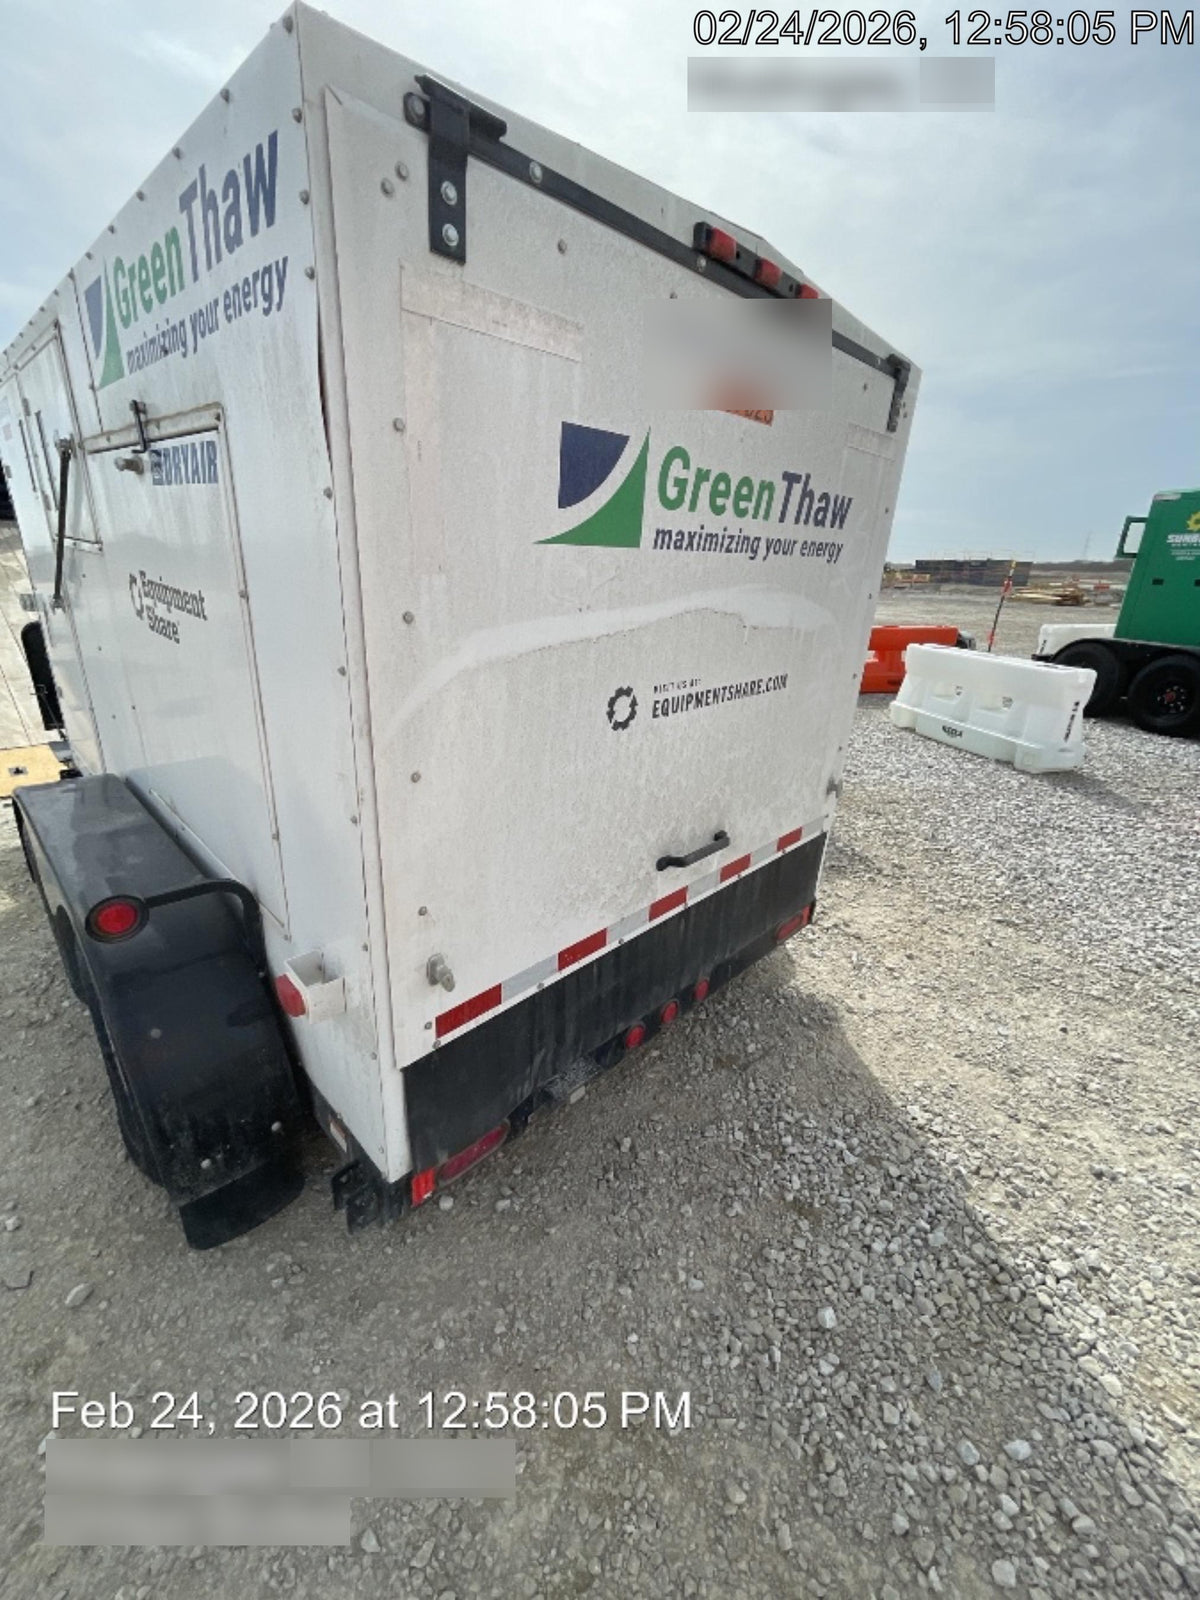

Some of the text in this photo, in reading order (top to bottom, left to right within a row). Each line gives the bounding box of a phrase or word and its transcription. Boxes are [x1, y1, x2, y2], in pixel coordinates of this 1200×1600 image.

[113, 130, 278, 329] GreenThaw
[126, 256, 289, 375] maximizing your energy
[657, 445, 854, 530] GreenThaw
[652, 524, 845, 564] maximizing your energy
[652, 673, 789, 719] EQUIPMENTSHARE.COM
